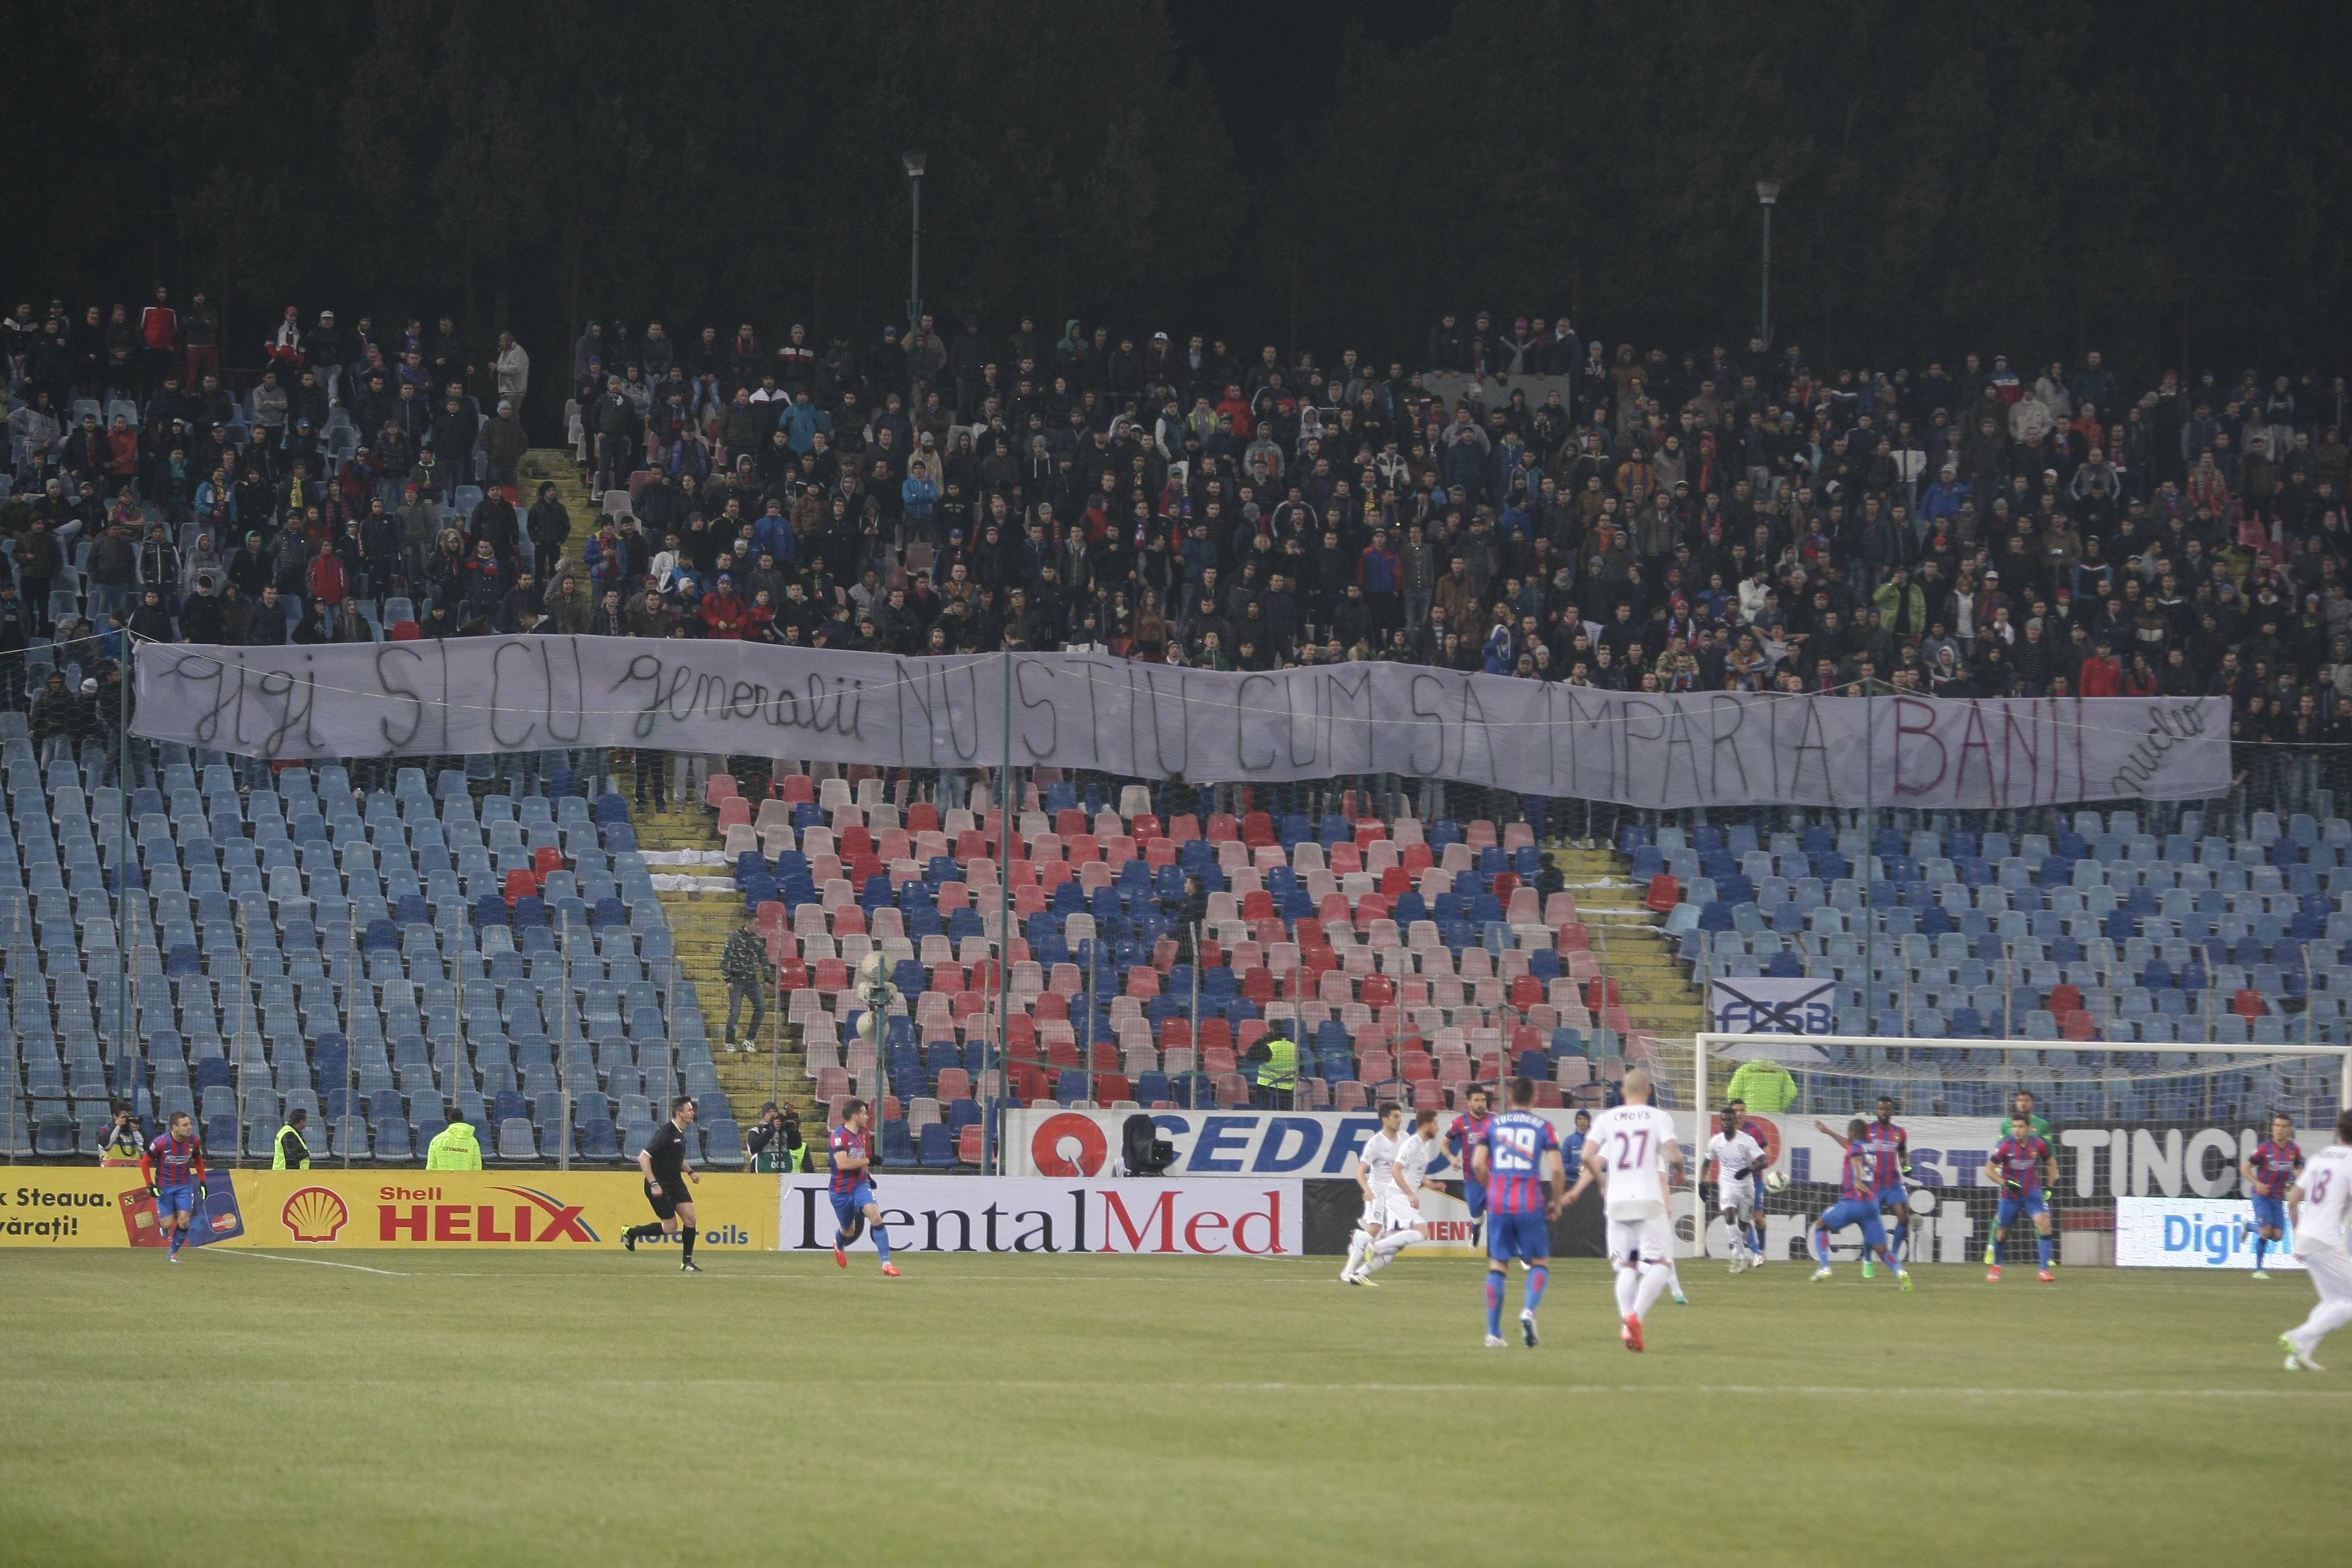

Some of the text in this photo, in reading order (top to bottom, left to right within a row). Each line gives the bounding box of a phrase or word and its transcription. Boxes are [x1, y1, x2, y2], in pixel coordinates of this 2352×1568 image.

[159, 653, 325, 757] gigi
[490, 638, 583, 748] CU
[608, 654, 863, 742] generalii
[895, 659, 978, 766] NU
[1238, 669, 1372, 771] CUM
[1894, 695, 2085, 808] BANII
[1495, 1127, 1536, 1169] 29
[1614, 1129, 1649, 1170] 27
[16, 1187, 112, 1207] Steaua.
[380, 1186, 442, 1200] Shell
[377, 1204, 592, 1242] HELIX
[705, 1224, 749, 1244] oils
